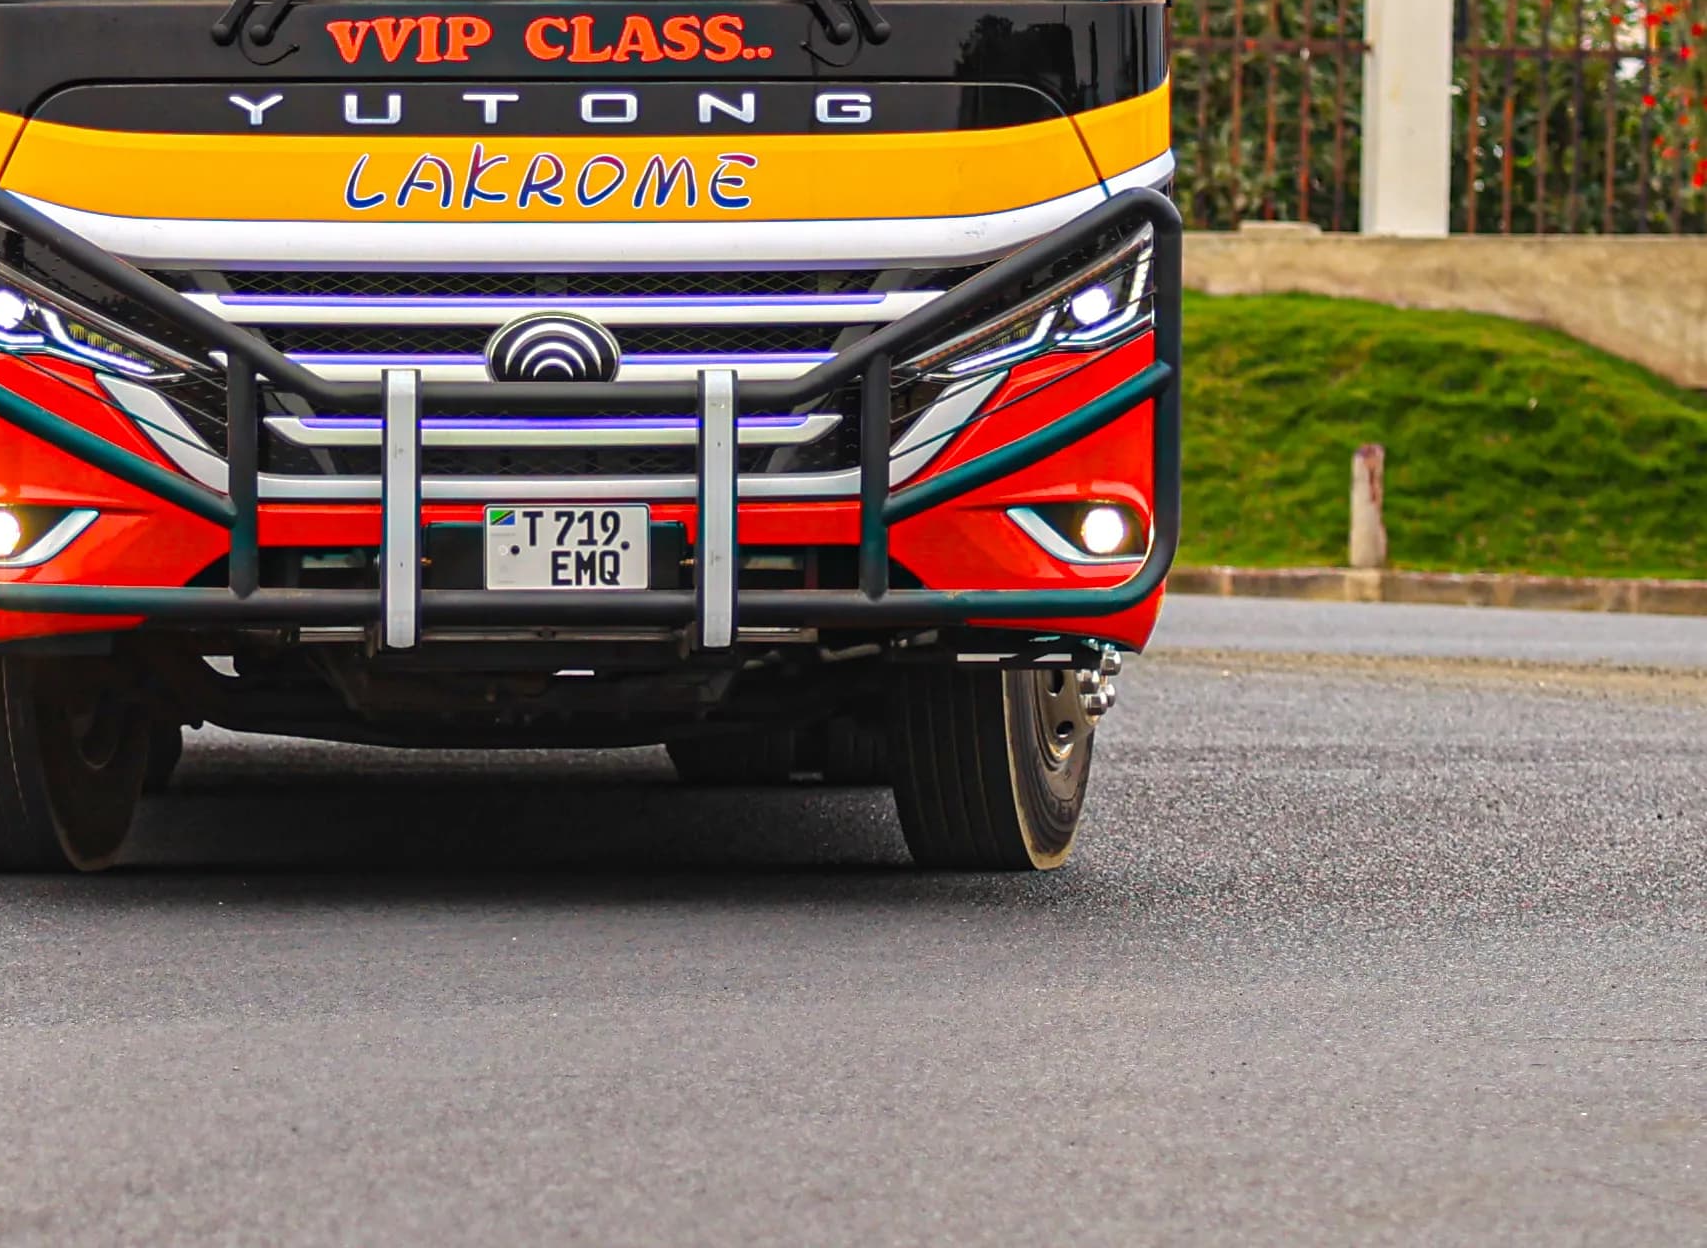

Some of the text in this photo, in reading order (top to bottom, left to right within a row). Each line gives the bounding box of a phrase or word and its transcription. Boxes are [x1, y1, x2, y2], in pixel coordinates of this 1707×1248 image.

[326, 16, 493, 64] VVIP
[229, 92, 873, 126] YUTONG
[344, 143, 759, 210] LAKROME
[522, 510, 622, 547] T 719
[551, 549, 621, 587] EMQ
